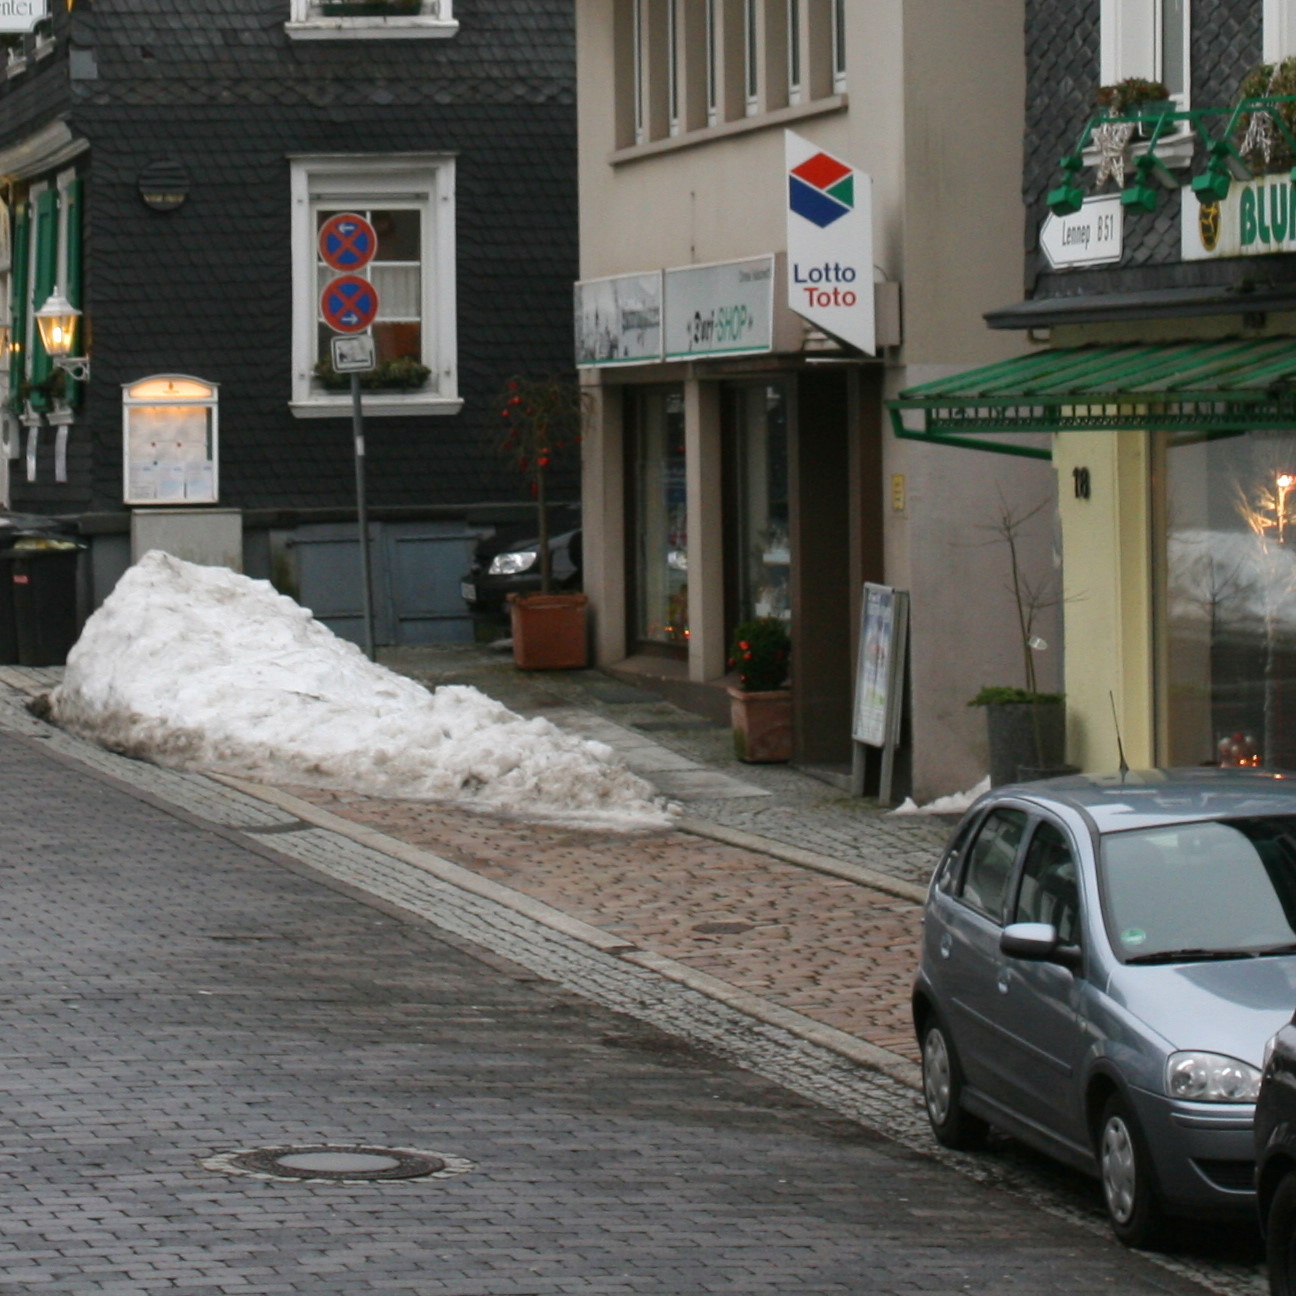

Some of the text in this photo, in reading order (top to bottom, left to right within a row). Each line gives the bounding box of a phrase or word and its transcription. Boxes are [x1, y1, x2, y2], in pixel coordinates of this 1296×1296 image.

[1062, 219, 1091, 251] Lennep
[794, 262, 856, 283] Lotto
[803, 287, 857, 308] Toto
[1072, 466, 1091, 500] 18
